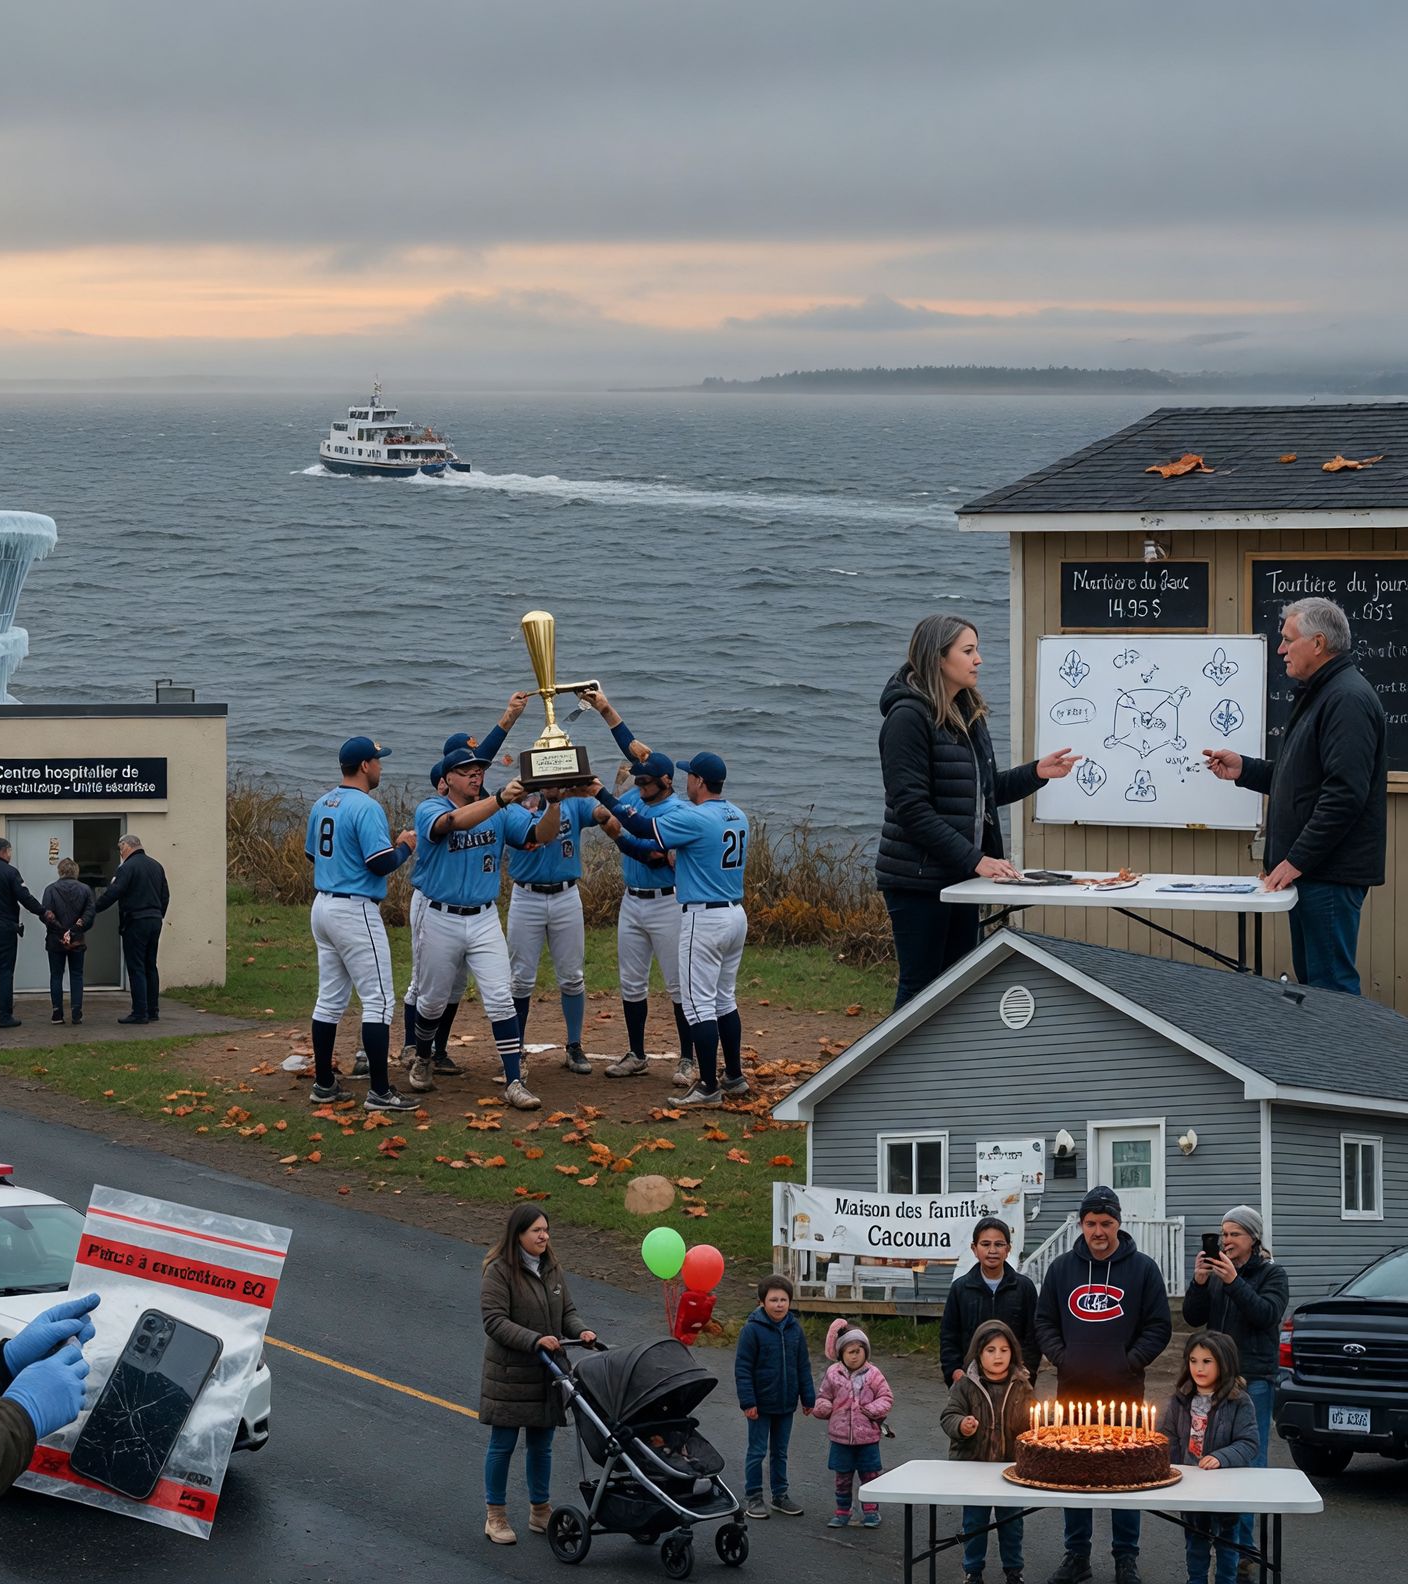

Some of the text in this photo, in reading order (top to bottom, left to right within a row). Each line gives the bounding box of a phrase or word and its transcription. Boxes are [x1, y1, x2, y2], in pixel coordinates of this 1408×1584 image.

[45, 765, 116, 781] hospitalier
[122, 765, 139, 778] de
[319, 816, 335, 858] 8
[834, 1198, 890, 1218] Maison
[896, 1201, 922, 1219] des
[868, 1225, 952, 1248] Cacouna
